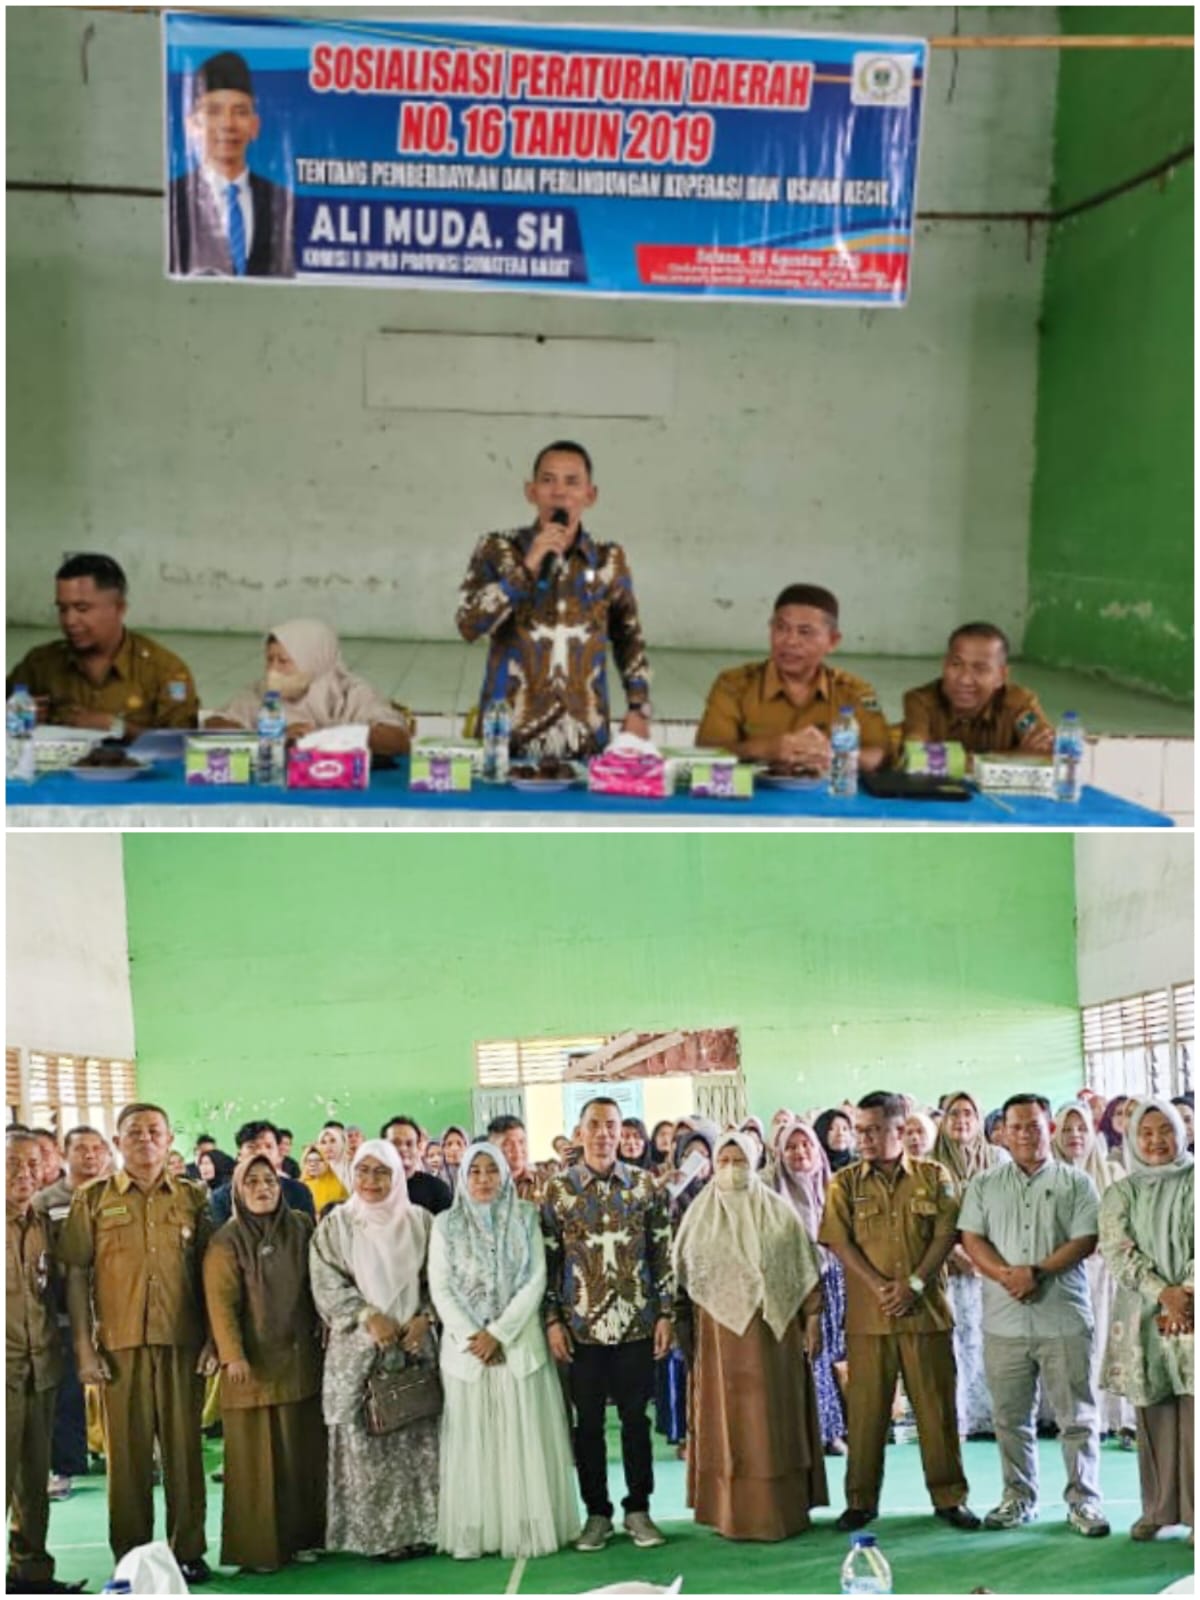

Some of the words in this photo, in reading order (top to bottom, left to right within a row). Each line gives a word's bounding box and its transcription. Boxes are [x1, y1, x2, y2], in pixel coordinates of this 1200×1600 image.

[311, 46, 501, 95] SOSIALISASI
[509, 52, 684, 104] PERATURAN
[690, 59, 812, 109] DAERAH
[401, 104, 456, 154] NO.
[463, 106, 504, 154] 16
[511, 108, 622, 160] TAHUN
[626, 112, 713, 164] 2019
[296, 158, 366, 186] TENTANG
[502, 167, 535, 193] DAN
[539, 168, 661, 198] PERLINDUNGAN
[663, 173, 743, 200] KOPERASI
[786, 178, 842, 205] USAHA
[844, 180, 888, 206] KECIL
[310, 204, 371, 244] ALI
[384, 207, 503, 249] MUDA.
[516, 212, 564, 252] SH
[463, 254, 529, 275] SUMATERA
